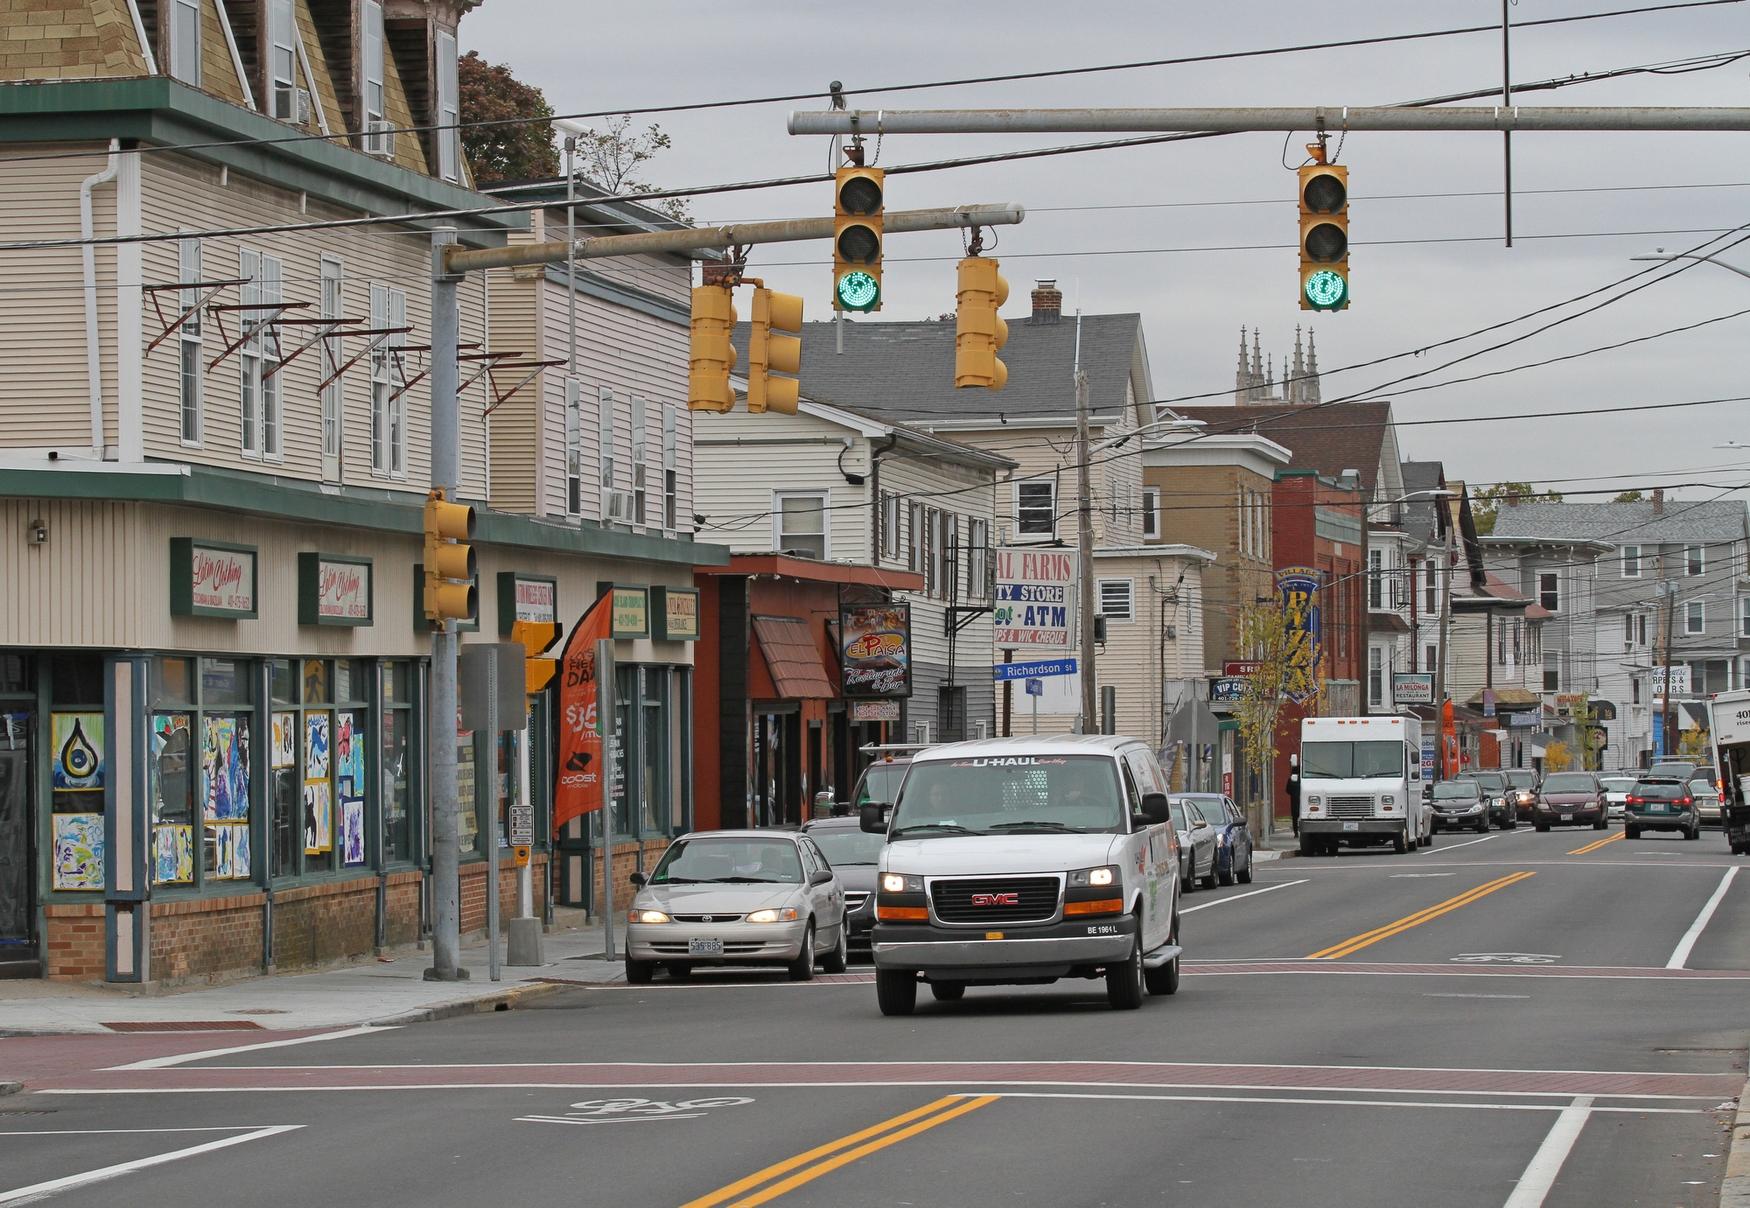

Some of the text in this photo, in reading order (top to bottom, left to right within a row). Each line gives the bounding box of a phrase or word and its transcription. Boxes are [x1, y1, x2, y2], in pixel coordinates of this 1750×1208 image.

[1022, 553, 1071, 581] FARMS
[213, 556, 241, 594] Clothing
[1021, 586, 1063, 603] STORE
[1024, 606, 1066, 627] ATM
[1018, 631, 1033, 643] WIC
[1036, 631, 1065, 645] CHEQUE
[850, 643, 864, 654] EL
[1007, 664, 1060, 677] Richardson
[1065, 664, 1073, 672] St
[1217, 683, 1230, 693] VIP
[973, 757, 1040, 768] U-HAUL
[561, 771, 597, 785] boost
[972, 892, 1018, 906] GMC
[1088, 926, 1097, 934] BE
